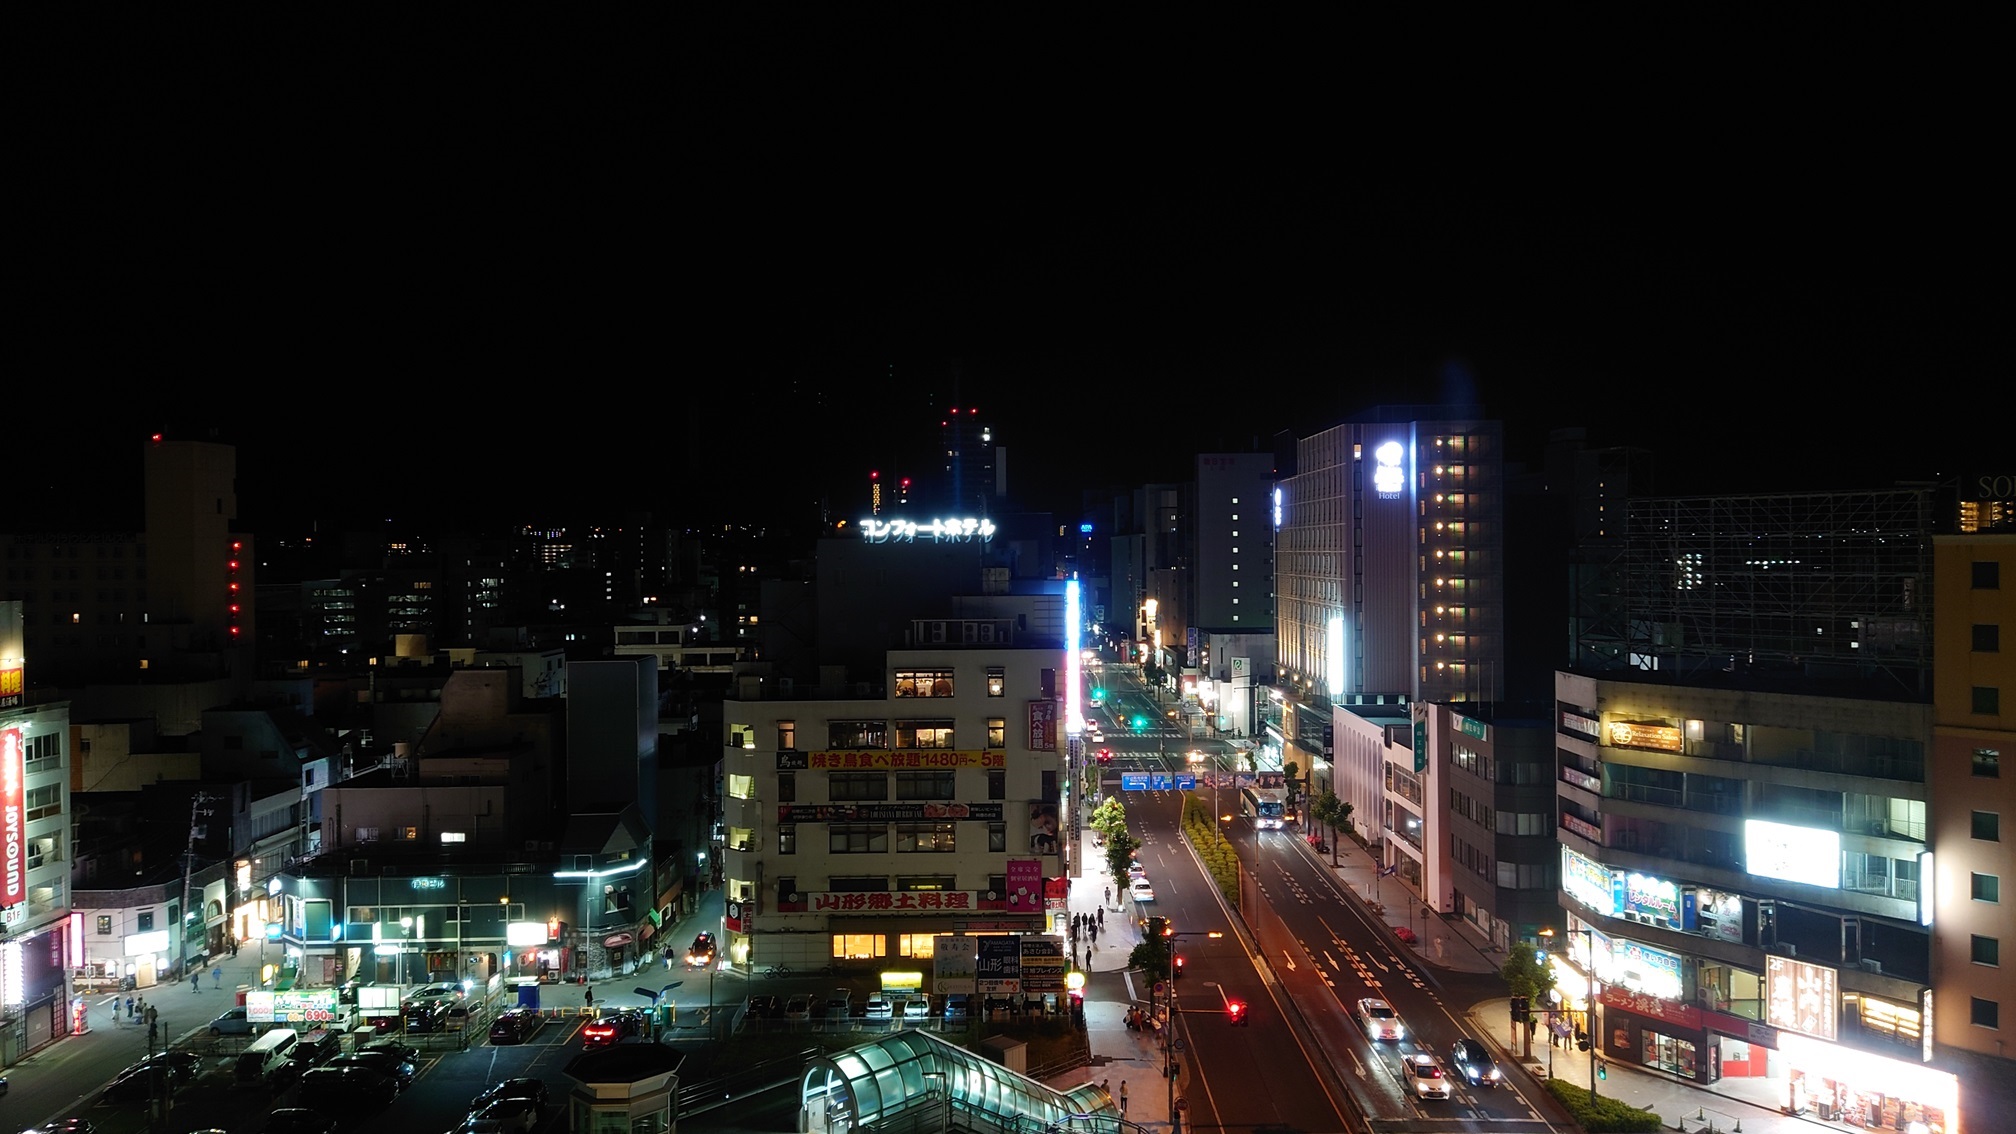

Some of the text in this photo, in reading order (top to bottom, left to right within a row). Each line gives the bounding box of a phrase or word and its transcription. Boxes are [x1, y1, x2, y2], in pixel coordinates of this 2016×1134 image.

[1978, 475, 2016, 498] SO
[1, 670, 21, 694] 料理
[1032, 711, 1043, 749] 食べ放題
[5, 805, 19, 896] JOYSOUND
[815, 892, 970, 910] 山形郷土料理
[1629, 889, 1677, 914] レンタルルーム
[6, 910, 21, 923] B1F
[978, 957, 1003, 972] 山形
[1769, 958, 1784, 970] 2F
[1606, 993, 1635, 1008] ラーメン
